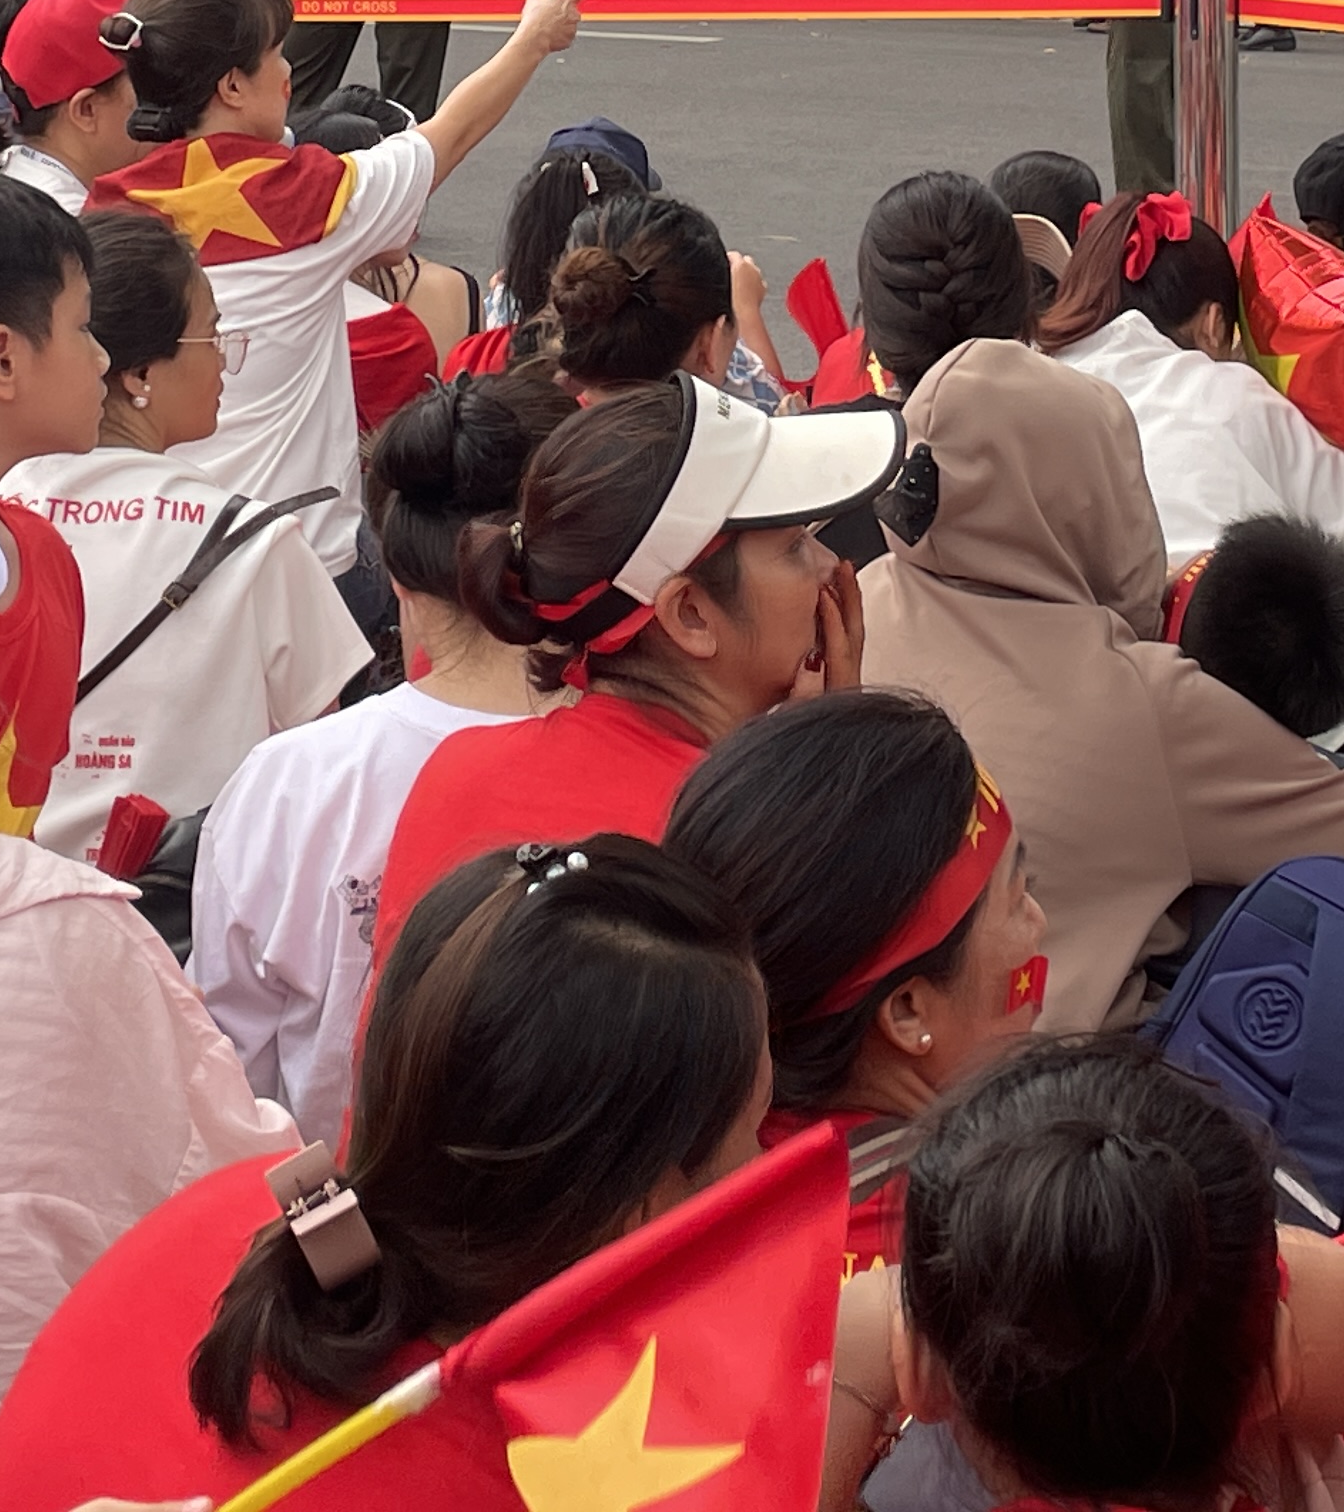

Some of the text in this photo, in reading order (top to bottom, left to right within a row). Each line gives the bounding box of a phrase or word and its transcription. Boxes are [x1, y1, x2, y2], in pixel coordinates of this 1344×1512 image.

[301, 0, 397, 14] DO NOT CROSS
[45, 497, 144, 524] TRONG
[154, 496, 205, 525] TIM
[75, 751, 131, 769] HOÀNG SA
